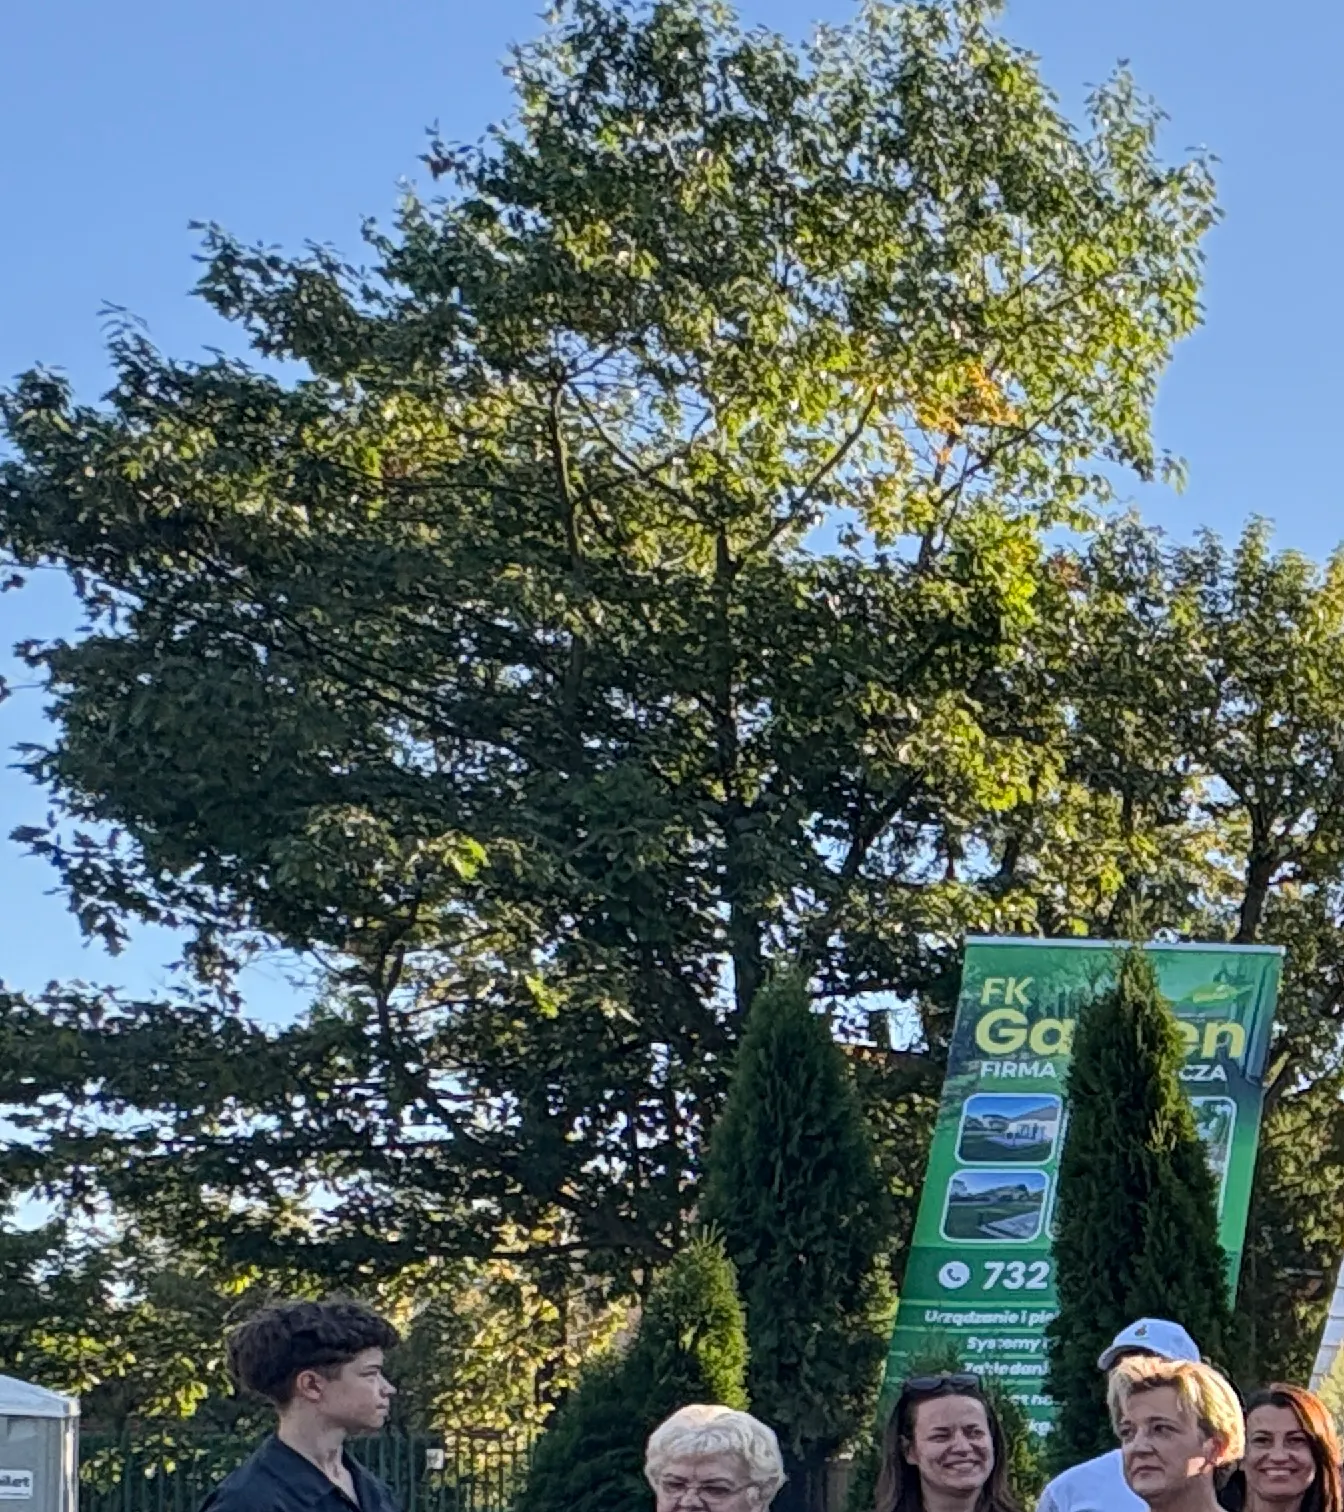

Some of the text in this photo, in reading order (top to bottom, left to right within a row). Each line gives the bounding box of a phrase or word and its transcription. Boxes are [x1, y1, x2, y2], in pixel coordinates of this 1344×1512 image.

[980, 976, 1034, 1006] FK
[975, 1007, 1246, 1058] Gaen
[980, 1060, 1057, 1079] FIRMA
[982, 1260, 1051, 1291] 732
